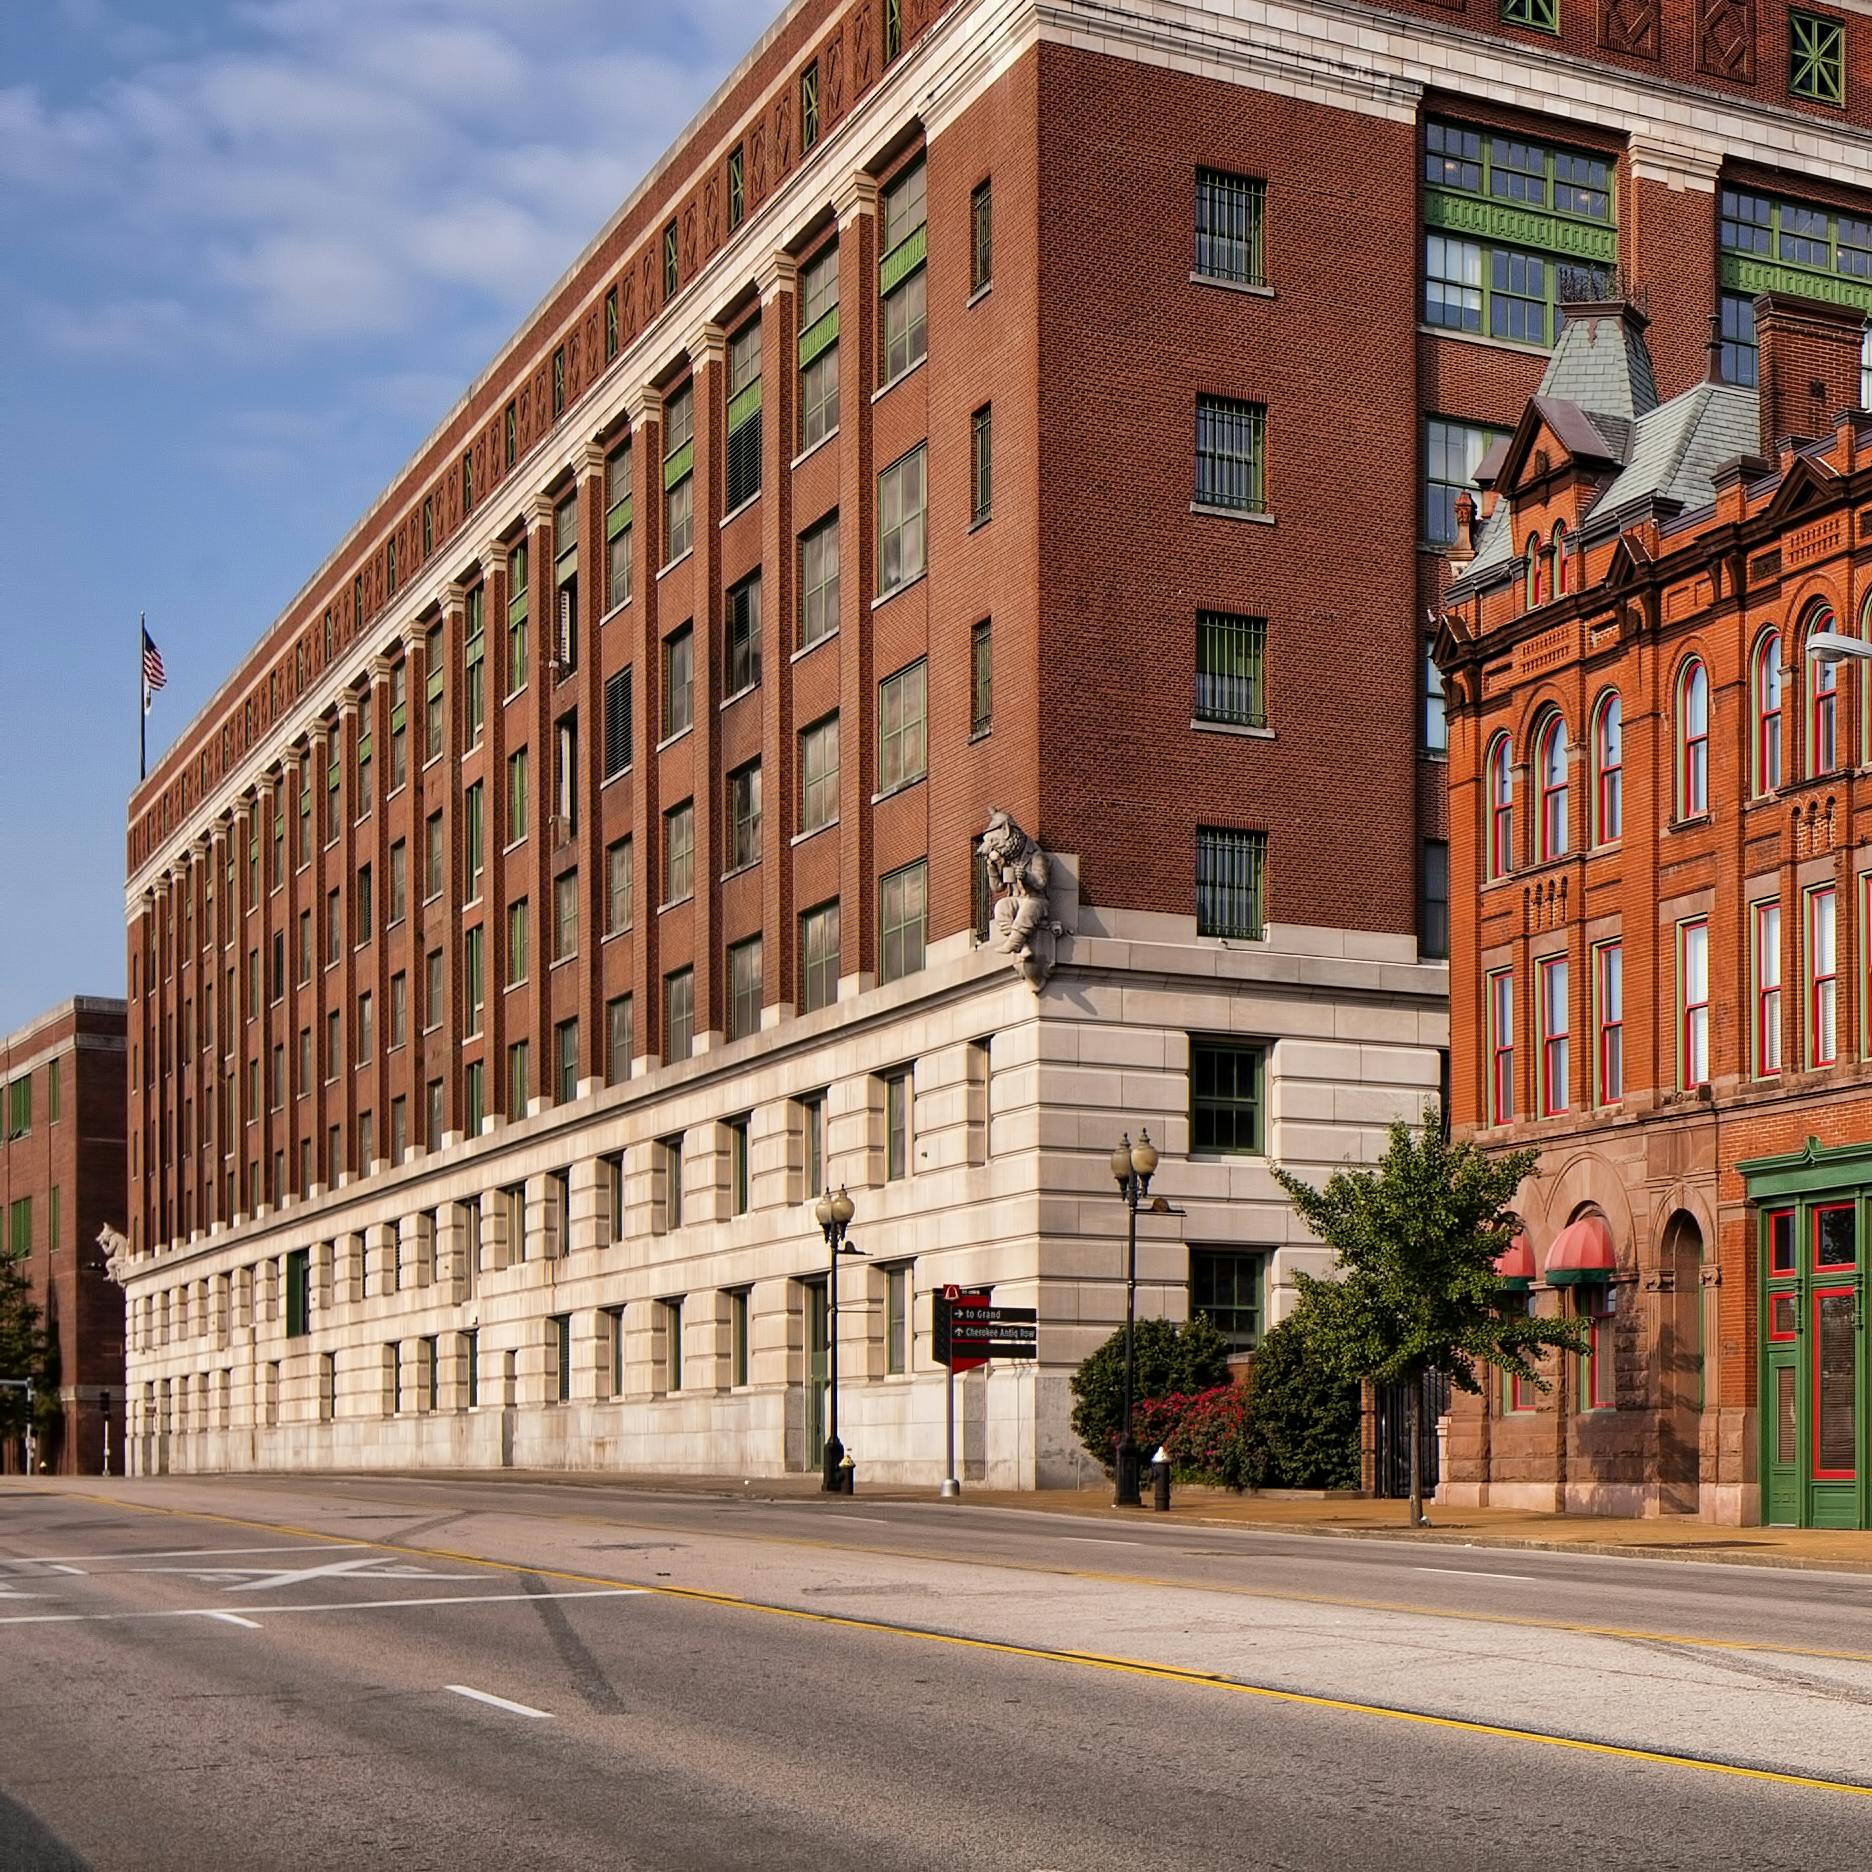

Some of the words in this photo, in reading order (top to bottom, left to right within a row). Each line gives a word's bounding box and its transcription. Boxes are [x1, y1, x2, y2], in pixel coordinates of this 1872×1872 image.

[966, 1310, 974, 1319] to
[977, 1310, 1001, 1319] Grand
[966, 1328, 998, 1337] Cherokee
